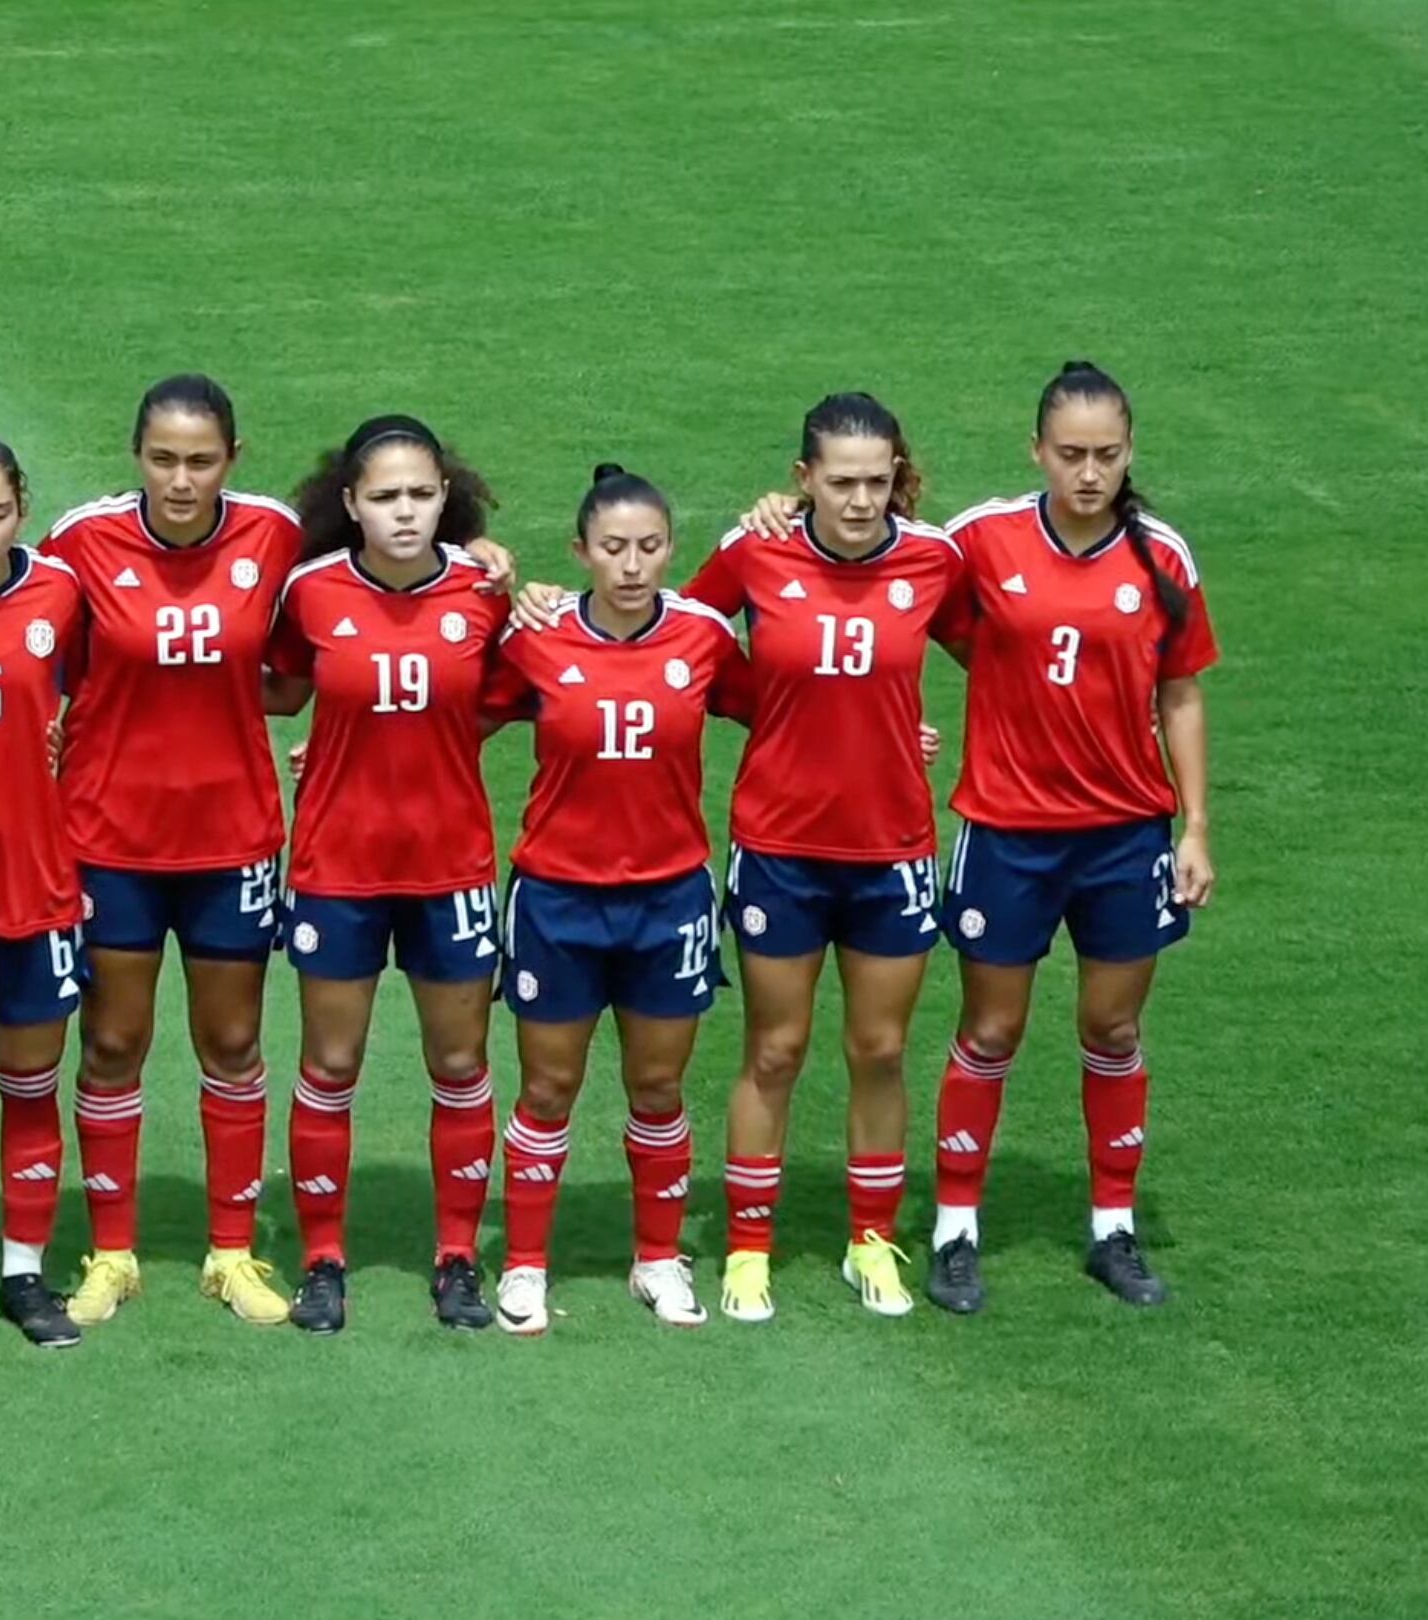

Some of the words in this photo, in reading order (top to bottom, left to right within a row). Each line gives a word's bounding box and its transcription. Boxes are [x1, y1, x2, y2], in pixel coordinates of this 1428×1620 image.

[156, 603, 222, 665] 22
[814, 614, 875, 676] 13
[1047, 626, 1081, 686] 3
[370, 652, 429, 713] 19
[596, 700, 655, 760] 12
[453, 885, 492, 941] 19
[893, 855, 935, 916] 13
[674, 914, 708, 979] 12
